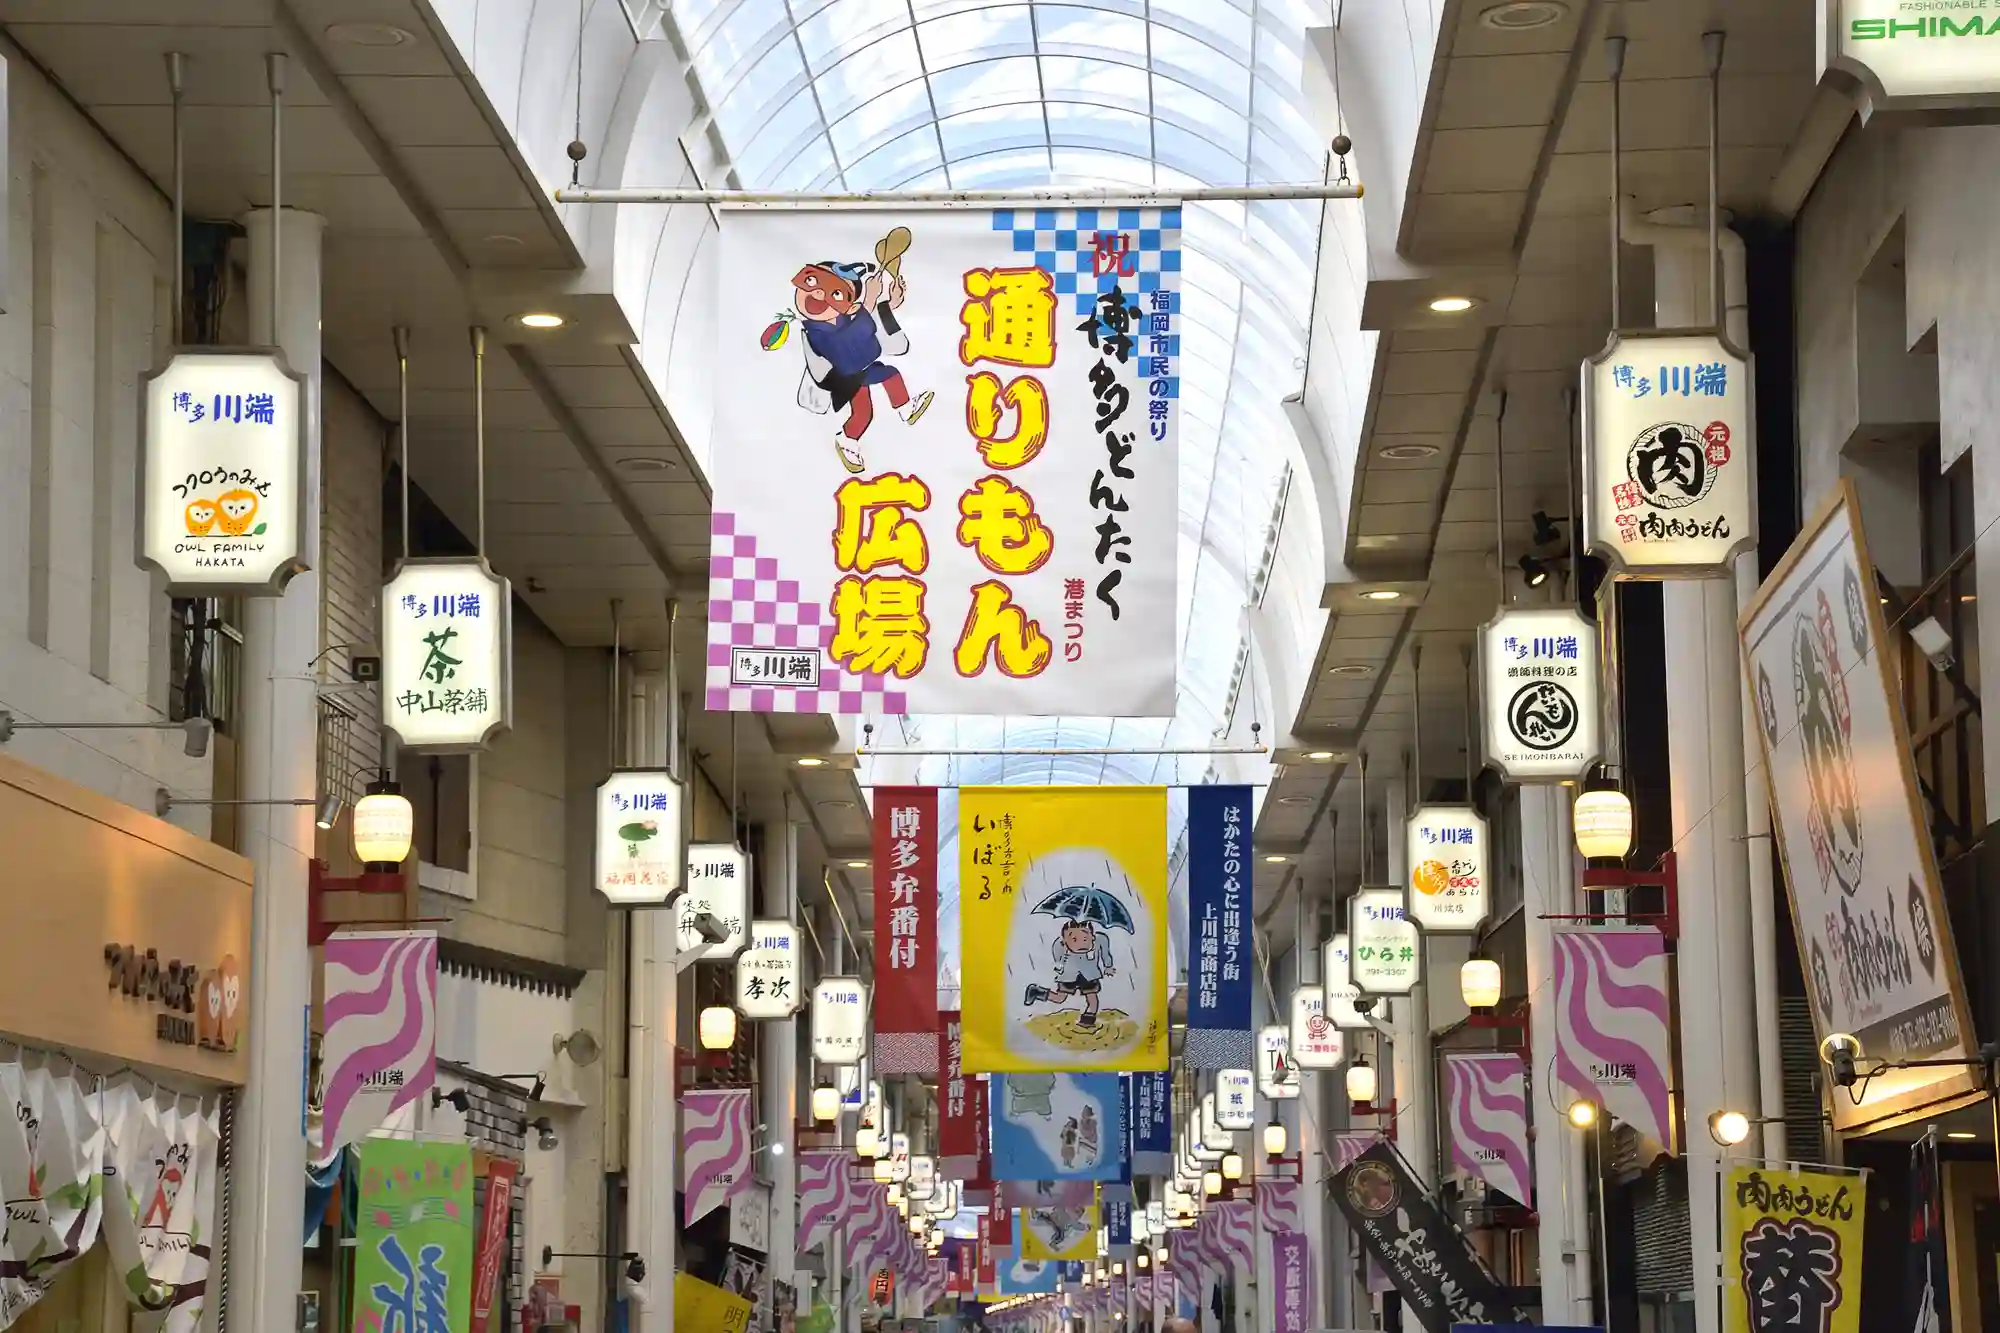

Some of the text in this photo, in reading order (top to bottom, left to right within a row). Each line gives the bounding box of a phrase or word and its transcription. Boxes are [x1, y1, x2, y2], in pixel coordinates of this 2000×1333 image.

[1086, 231, 1135, 279] 祝
[1147, 289, 1172, 442] 福岡市民の祭り
[1612, 361, 1728, 399] 博多川端
[172, 392, 275, 425] 博多川端
[1076, 285, 1143, 621] 博多どんたく
[1635, 427, 1706, 497] 肉
[1704, 421, 1731, 467] 元祖
[953, 264, 1058, 679] 通りもん
[1639, 511, 1731, 539] 肉肉うどん
[175, 544, 265, 554] OWL FAMILY
[195, 557, 245, 568] HAKATA
[828, 472, 932, 680] 広場
[402, 594, 481, 619] 博多川端
[1063, 577, 1085, 663] 港まつり
[420, 627, 462, 684] 茶
[740, 656, 811, 680] 博多川端
[1504, 635, 1578, 660] 博多川端
[611, 792, 667, 811] 博多川端
[973, 812, 1002, 900] いぼる
[1420, 827, 1473, 844] 博多川端
[889, 806, 921, 970] 博多弁番付
[678, 916, 741, 936] 井端
[1199, 902, 1218, 1009] 上川端商店街
[744, 975, 791, 1000] 孝次
[1737, 1172, 1852, 1221] 肉肉うどん
